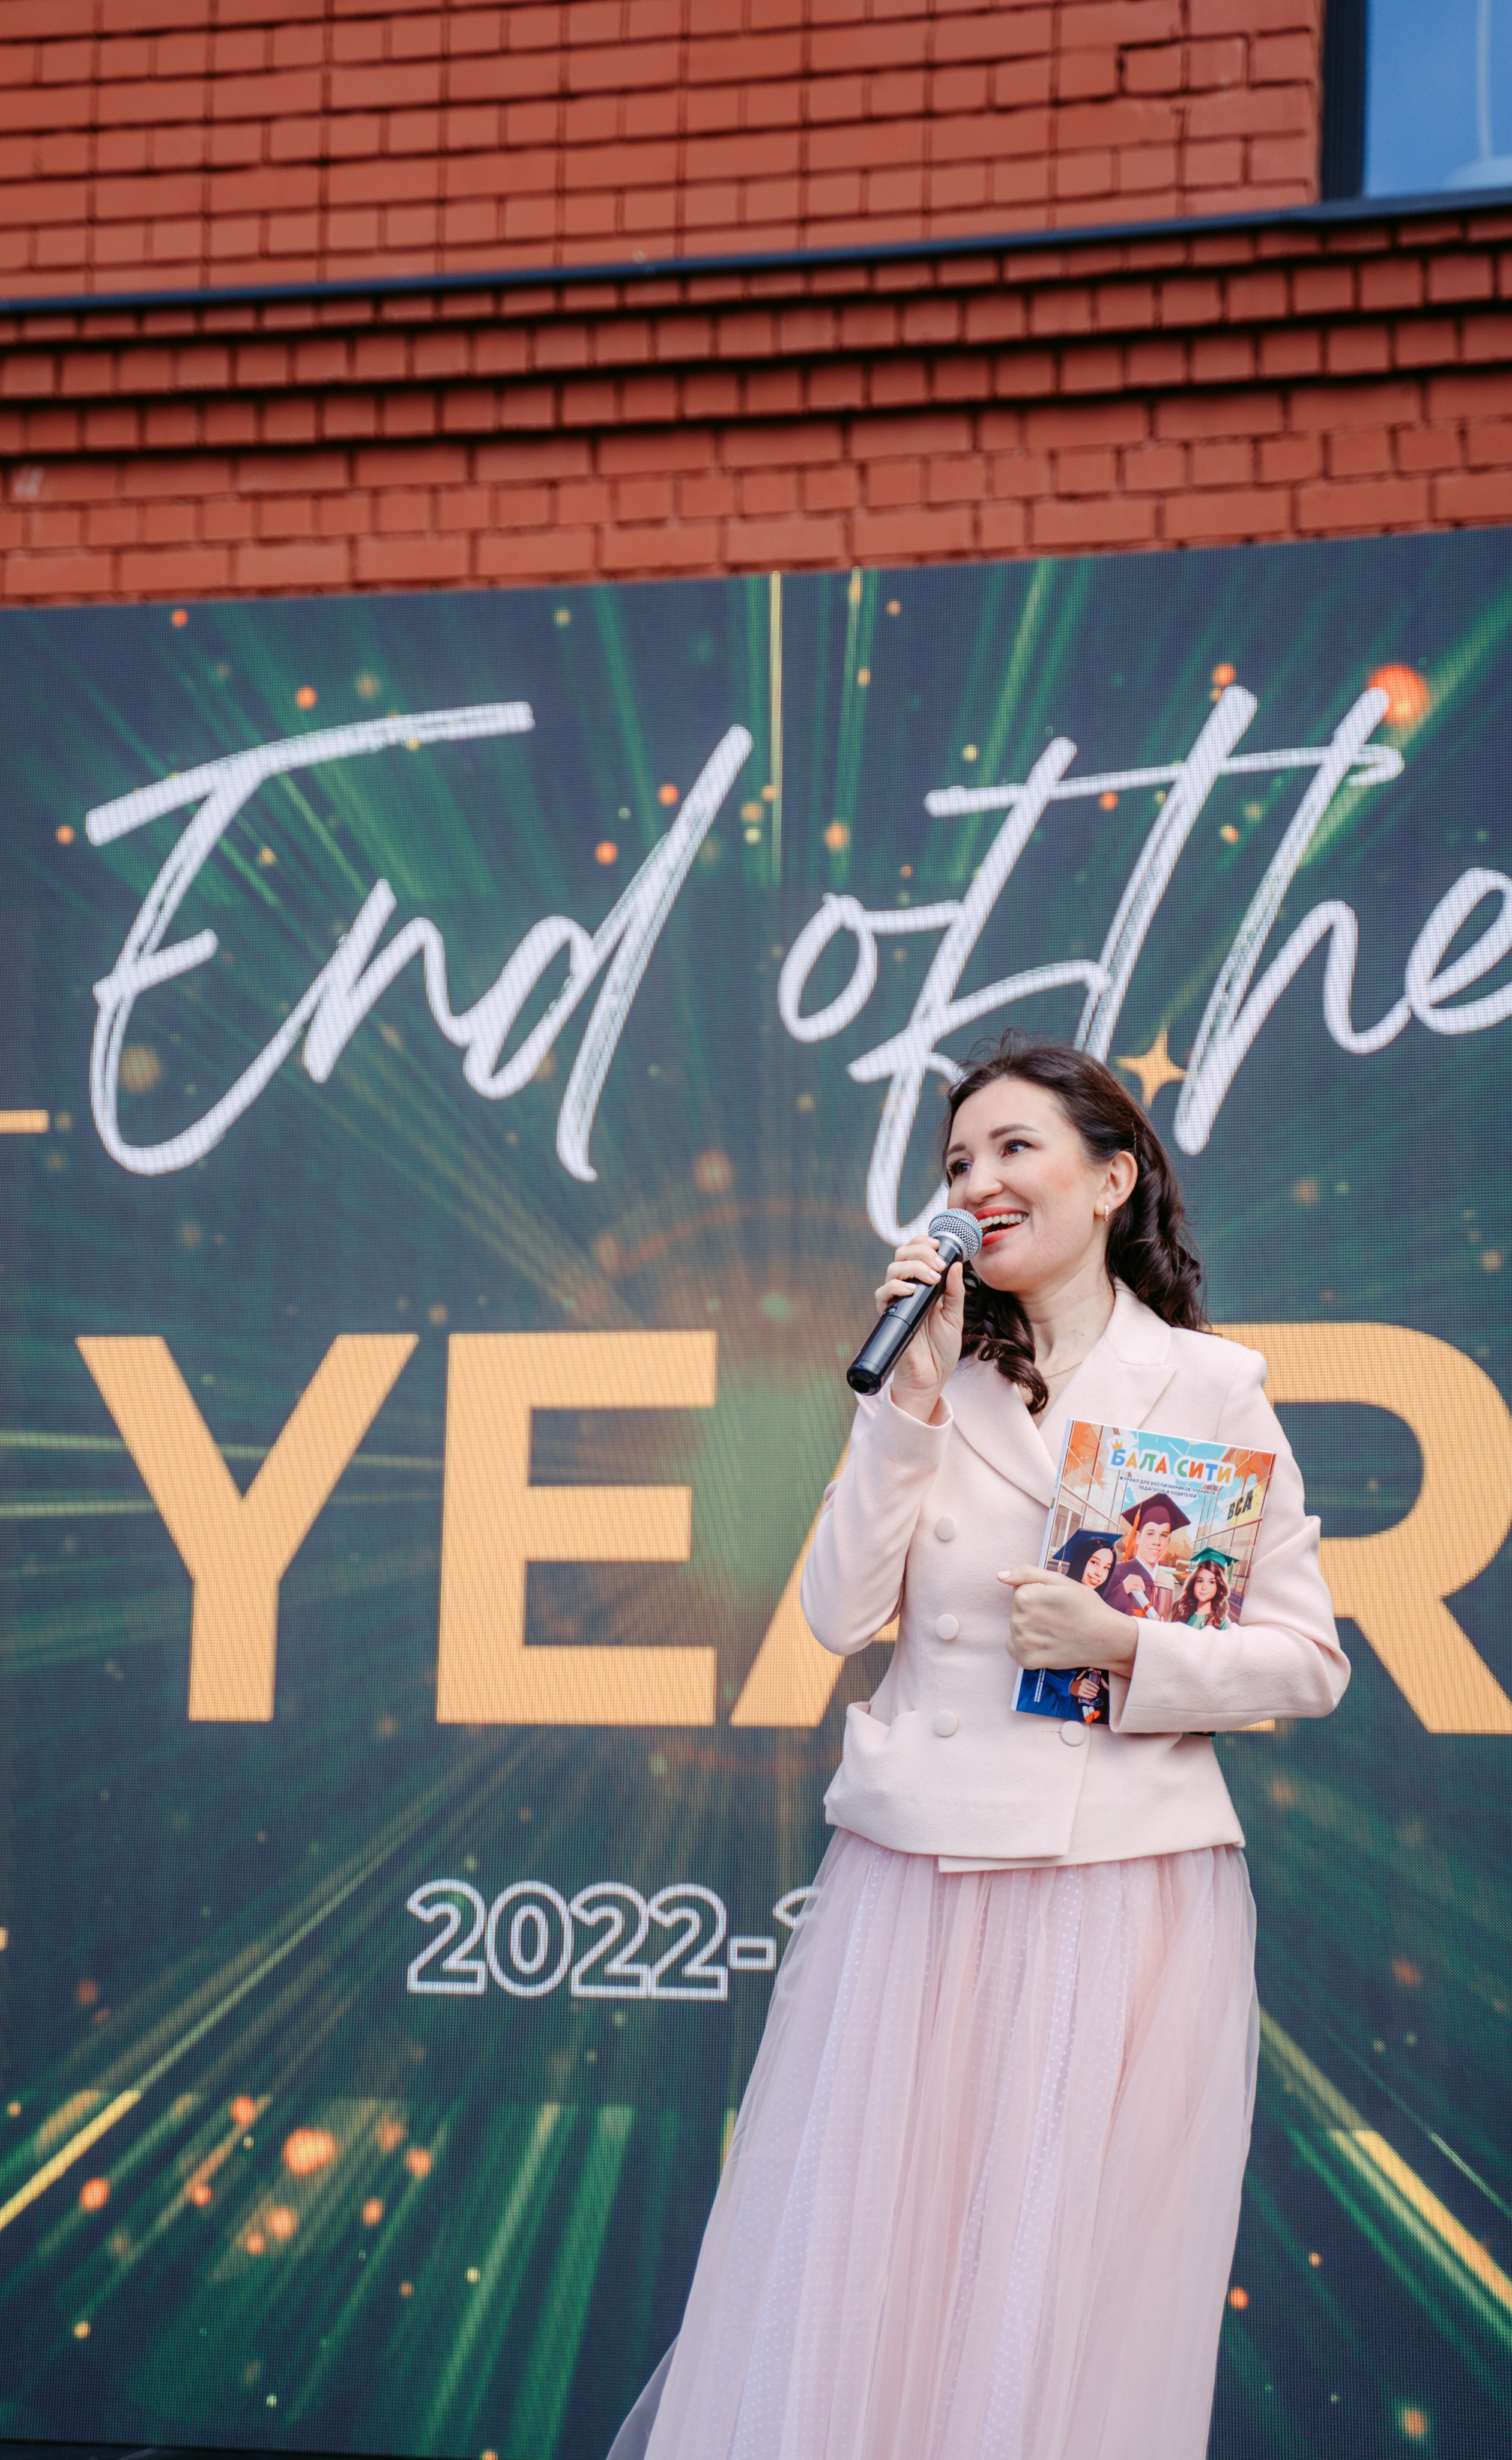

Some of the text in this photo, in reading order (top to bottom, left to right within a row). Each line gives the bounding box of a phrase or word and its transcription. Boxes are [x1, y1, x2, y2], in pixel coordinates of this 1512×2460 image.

[85, 686, 1512, 1247] End of the
[1111, 1449, 1232, 1483] БАЛА СИТИ
[407, 1878, 823, 2001] 2022-
